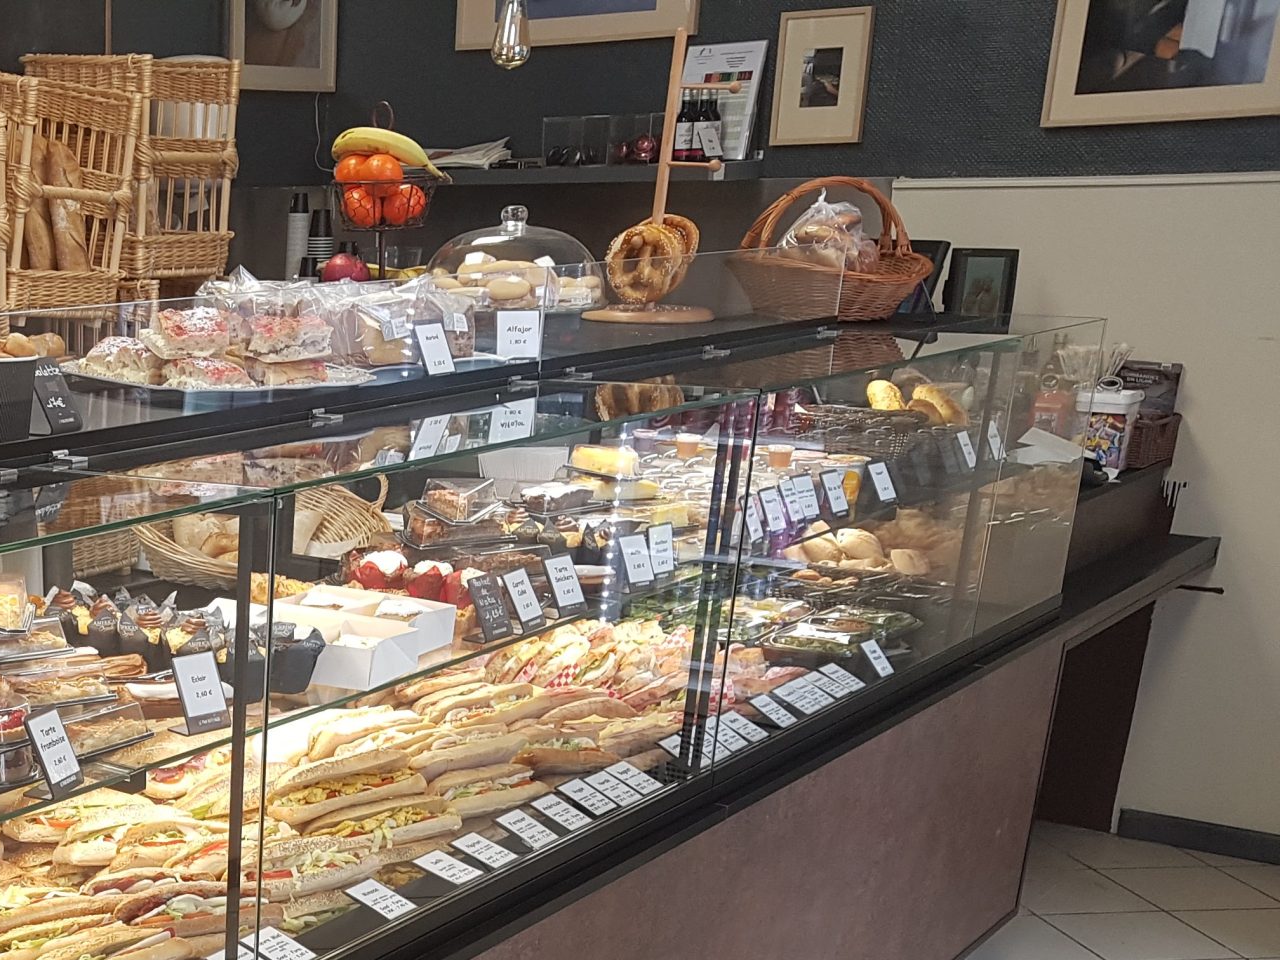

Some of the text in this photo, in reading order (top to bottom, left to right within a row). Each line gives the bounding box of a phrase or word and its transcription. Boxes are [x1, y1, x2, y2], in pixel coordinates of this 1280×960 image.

[507, 327, 532, 335] Alfajor
[40, 726, 57, 738] Tarte
[40, 735, 66, 753] framboise
